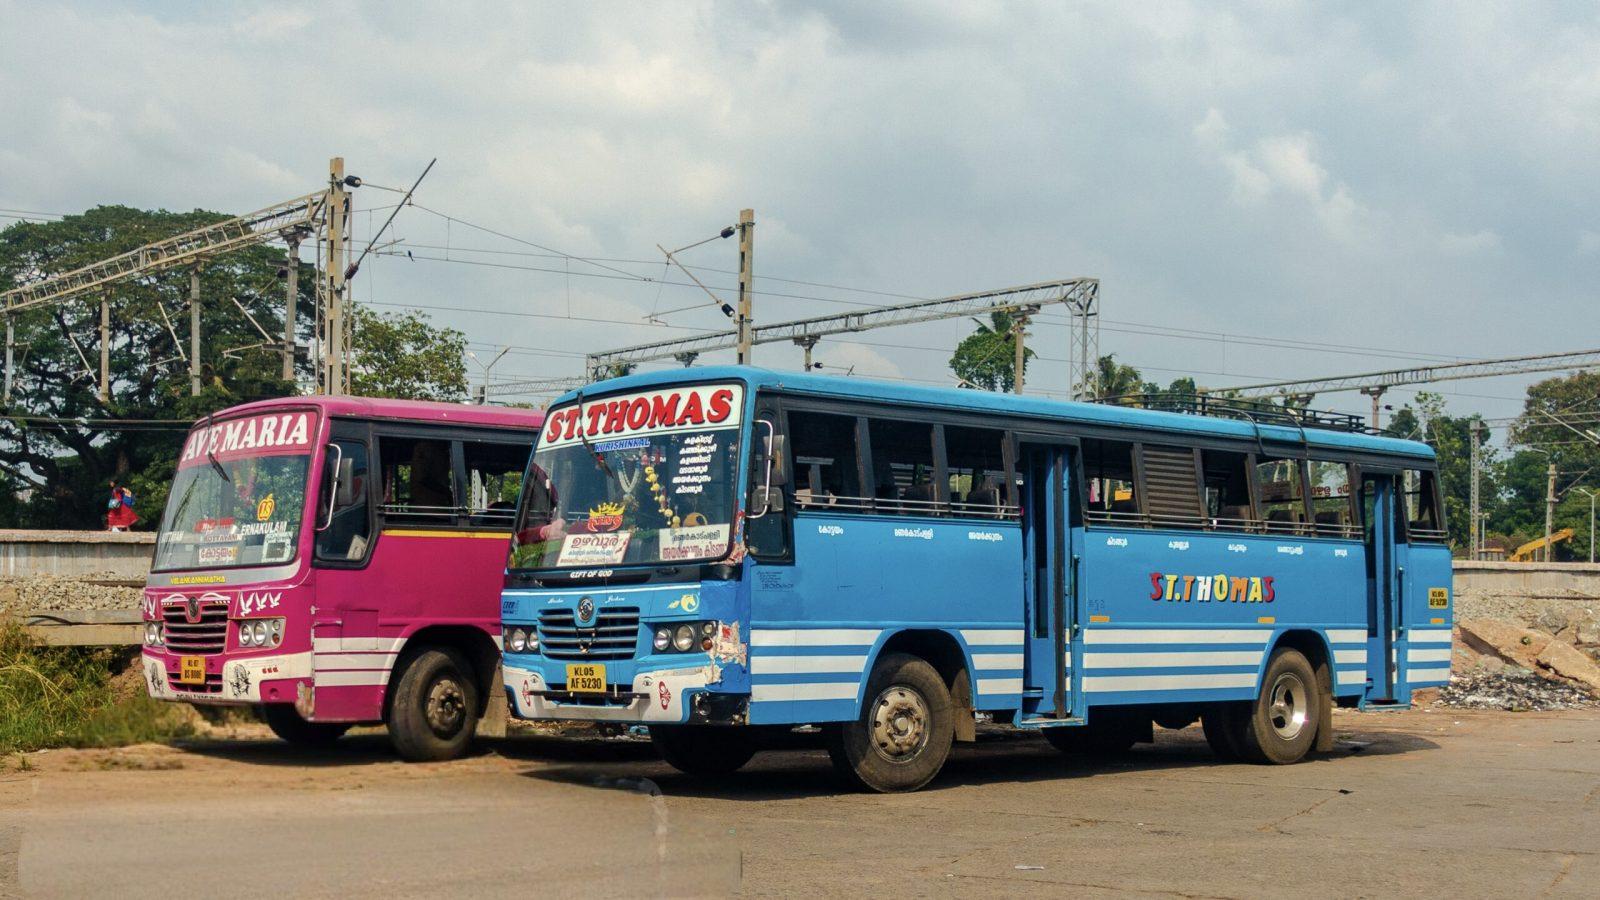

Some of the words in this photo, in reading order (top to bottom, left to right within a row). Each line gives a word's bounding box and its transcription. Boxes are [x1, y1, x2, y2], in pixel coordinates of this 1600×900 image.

[546, 389, 733, 443] ST.THOMAS
[182, 425, 223, 462] AVE
[220, 414, 308, 453] MARIA
[240, 520, 288, 535] ERNAKULAM
[587, 570, 598, 578] OF
[598, 569, 613, 577] GOD
[1150, 572, 1275, 602] ST.THOMAS
[570, 677, 580, 689] AF
[581, 677, 602, 689] 5230
